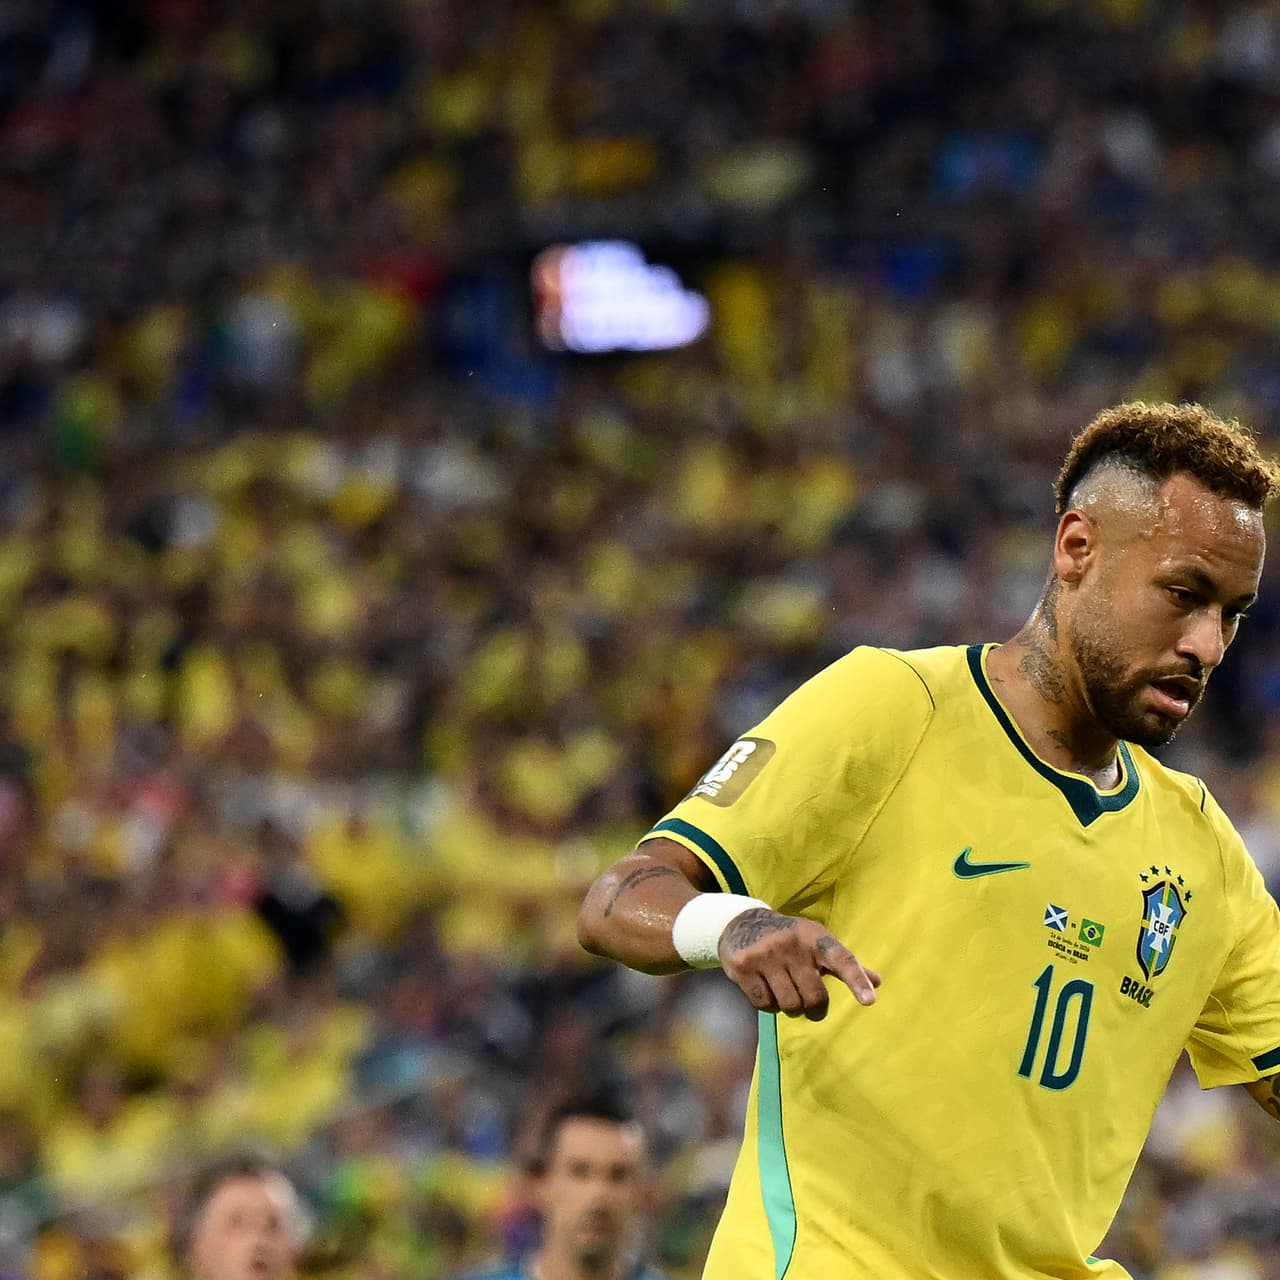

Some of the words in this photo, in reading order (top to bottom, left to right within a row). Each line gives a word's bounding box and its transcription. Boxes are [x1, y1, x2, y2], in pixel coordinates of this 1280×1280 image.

[1153, 920, 1170, 937] CBF
[1119, 976, 1155, 1009] BRASIL
[1017, 963, 1095, 1091] 10
